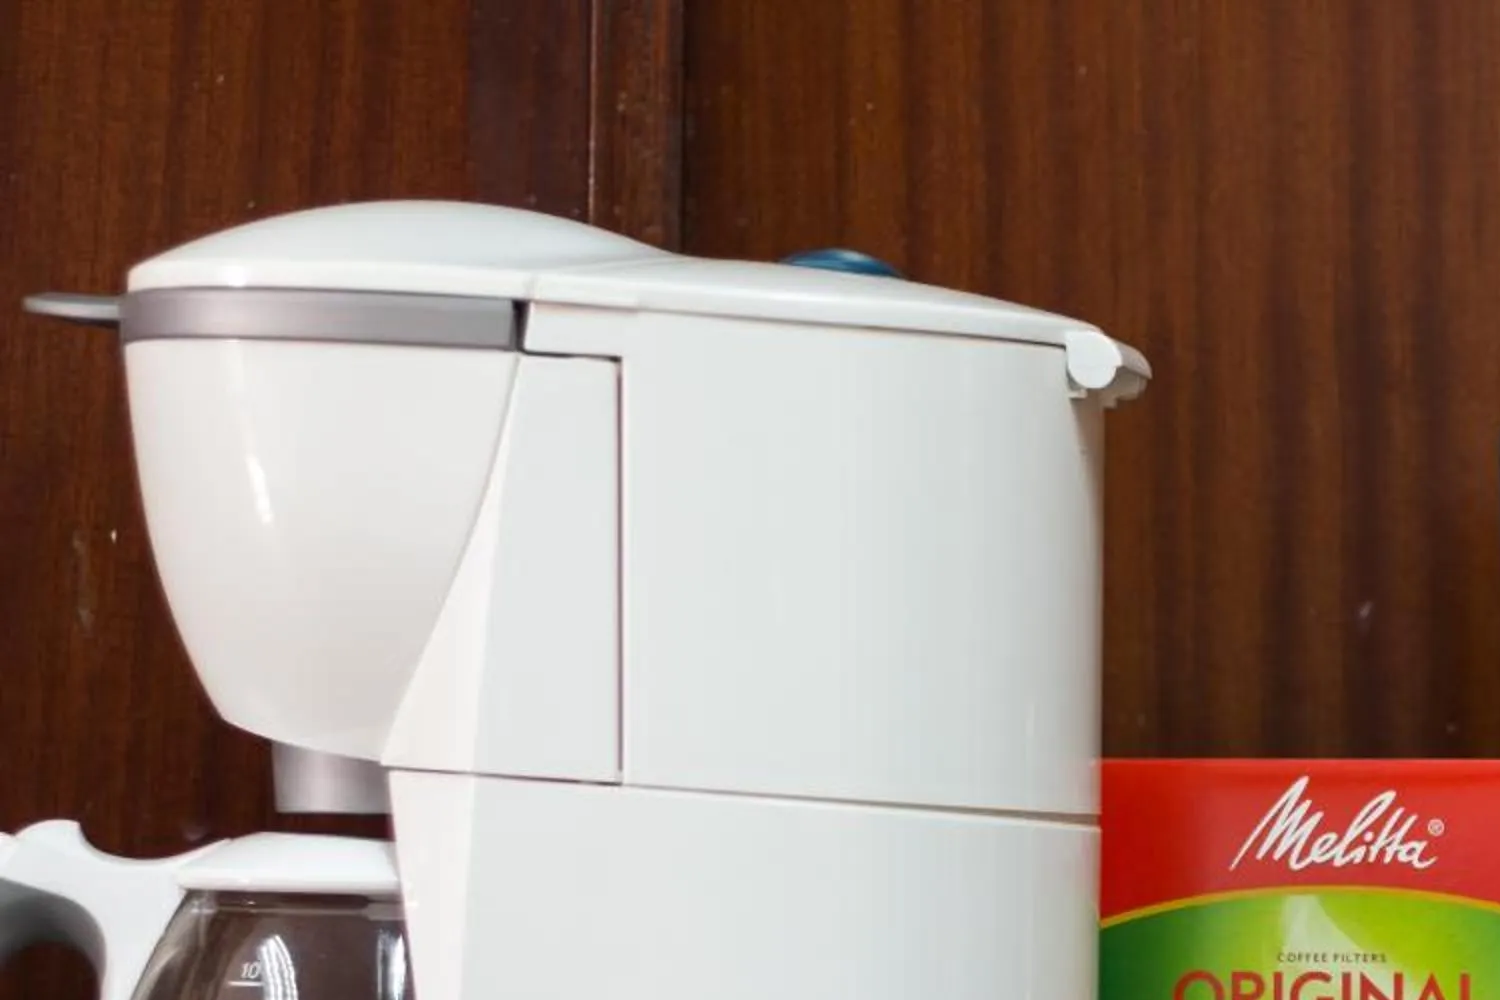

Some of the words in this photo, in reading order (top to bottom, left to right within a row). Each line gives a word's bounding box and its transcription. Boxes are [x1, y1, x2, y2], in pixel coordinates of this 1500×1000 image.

[1230, 776, 1438, 871] Melitta
[1276, 952, 1328, 964] COFFEE
[1333, 953, 1387, 964] FILTERS
